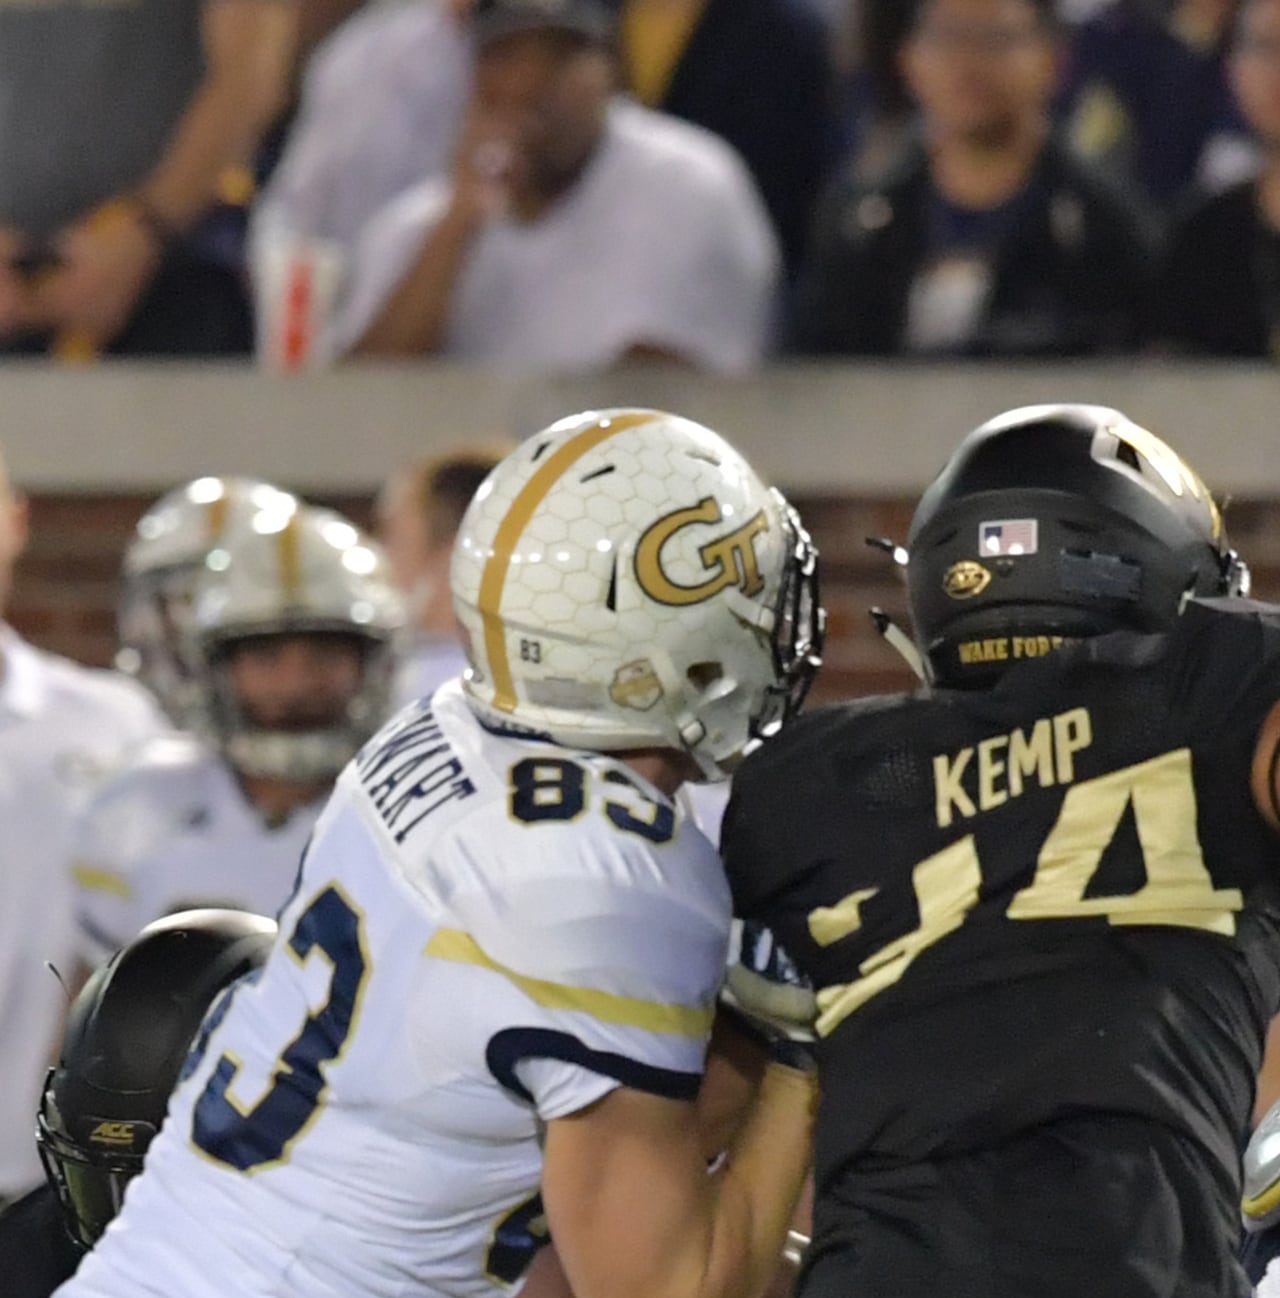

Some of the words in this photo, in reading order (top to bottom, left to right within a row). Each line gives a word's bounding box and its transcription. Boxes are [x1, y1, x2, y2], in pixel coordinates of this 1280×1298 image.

[634, 496, 770, 608] GT
[520, 639, 541, 664] 83
[958, 638, 1008, 664] WAKE
[1012, 635, 1085, 659] FOR
[932, 706, 1094, 829] KEMP
[178, 878, 374, 1184] 3
